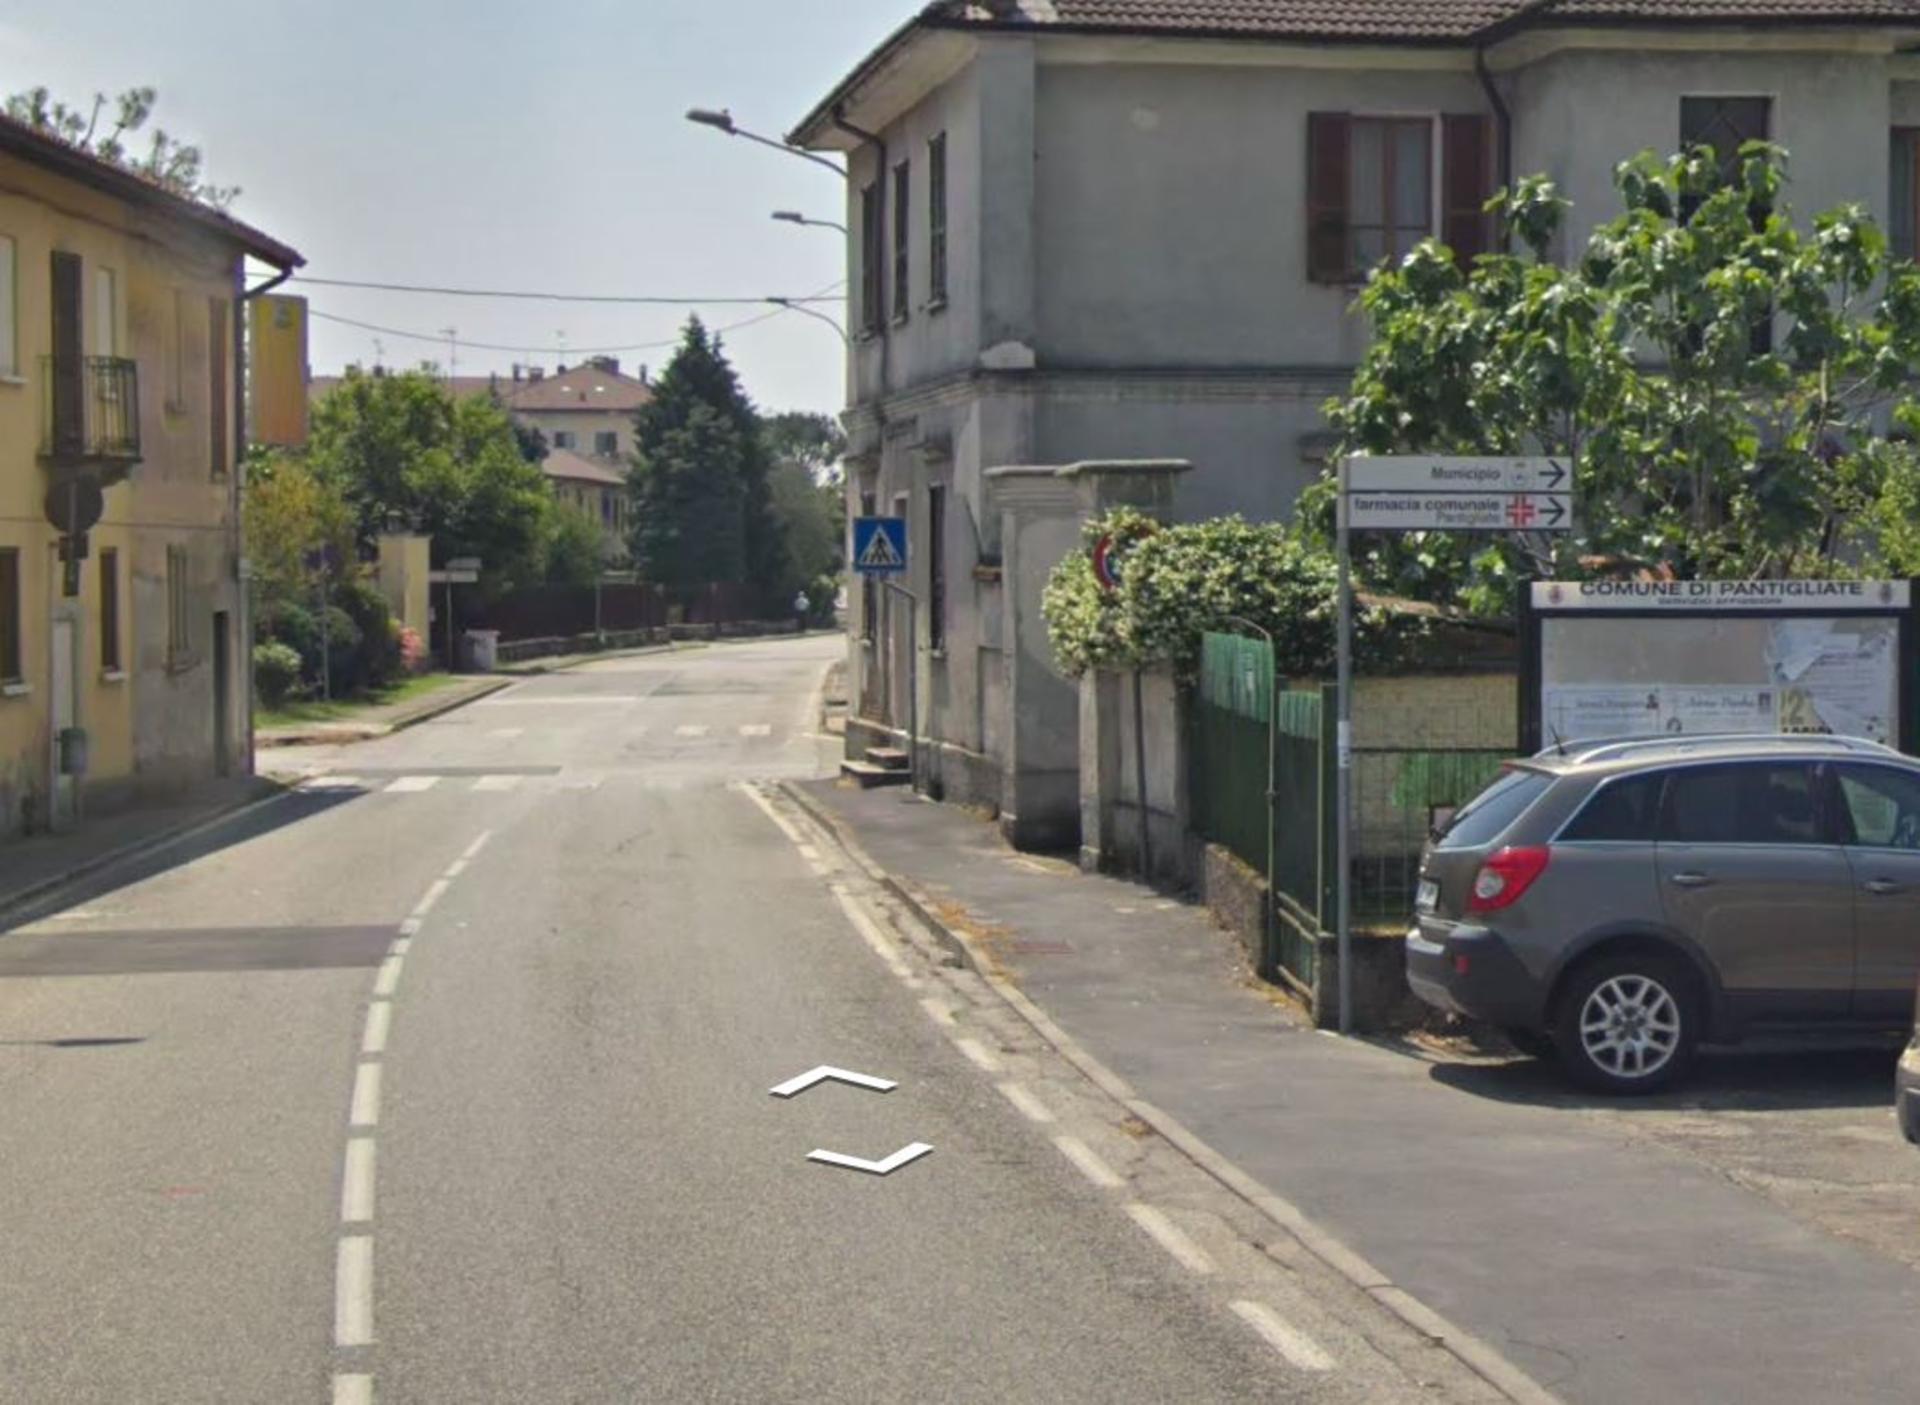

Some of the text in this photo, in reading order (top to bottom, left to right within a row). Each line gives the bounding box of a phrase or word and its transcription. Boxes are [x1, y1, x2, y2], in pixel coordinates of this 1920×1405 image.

[1431, 466, 1501, 481] Municipio
[1355, 497, 1500, 511] farmacia comunale
[1580, 580, 1864, 596] COMUNE DI PANTIGLIATE
